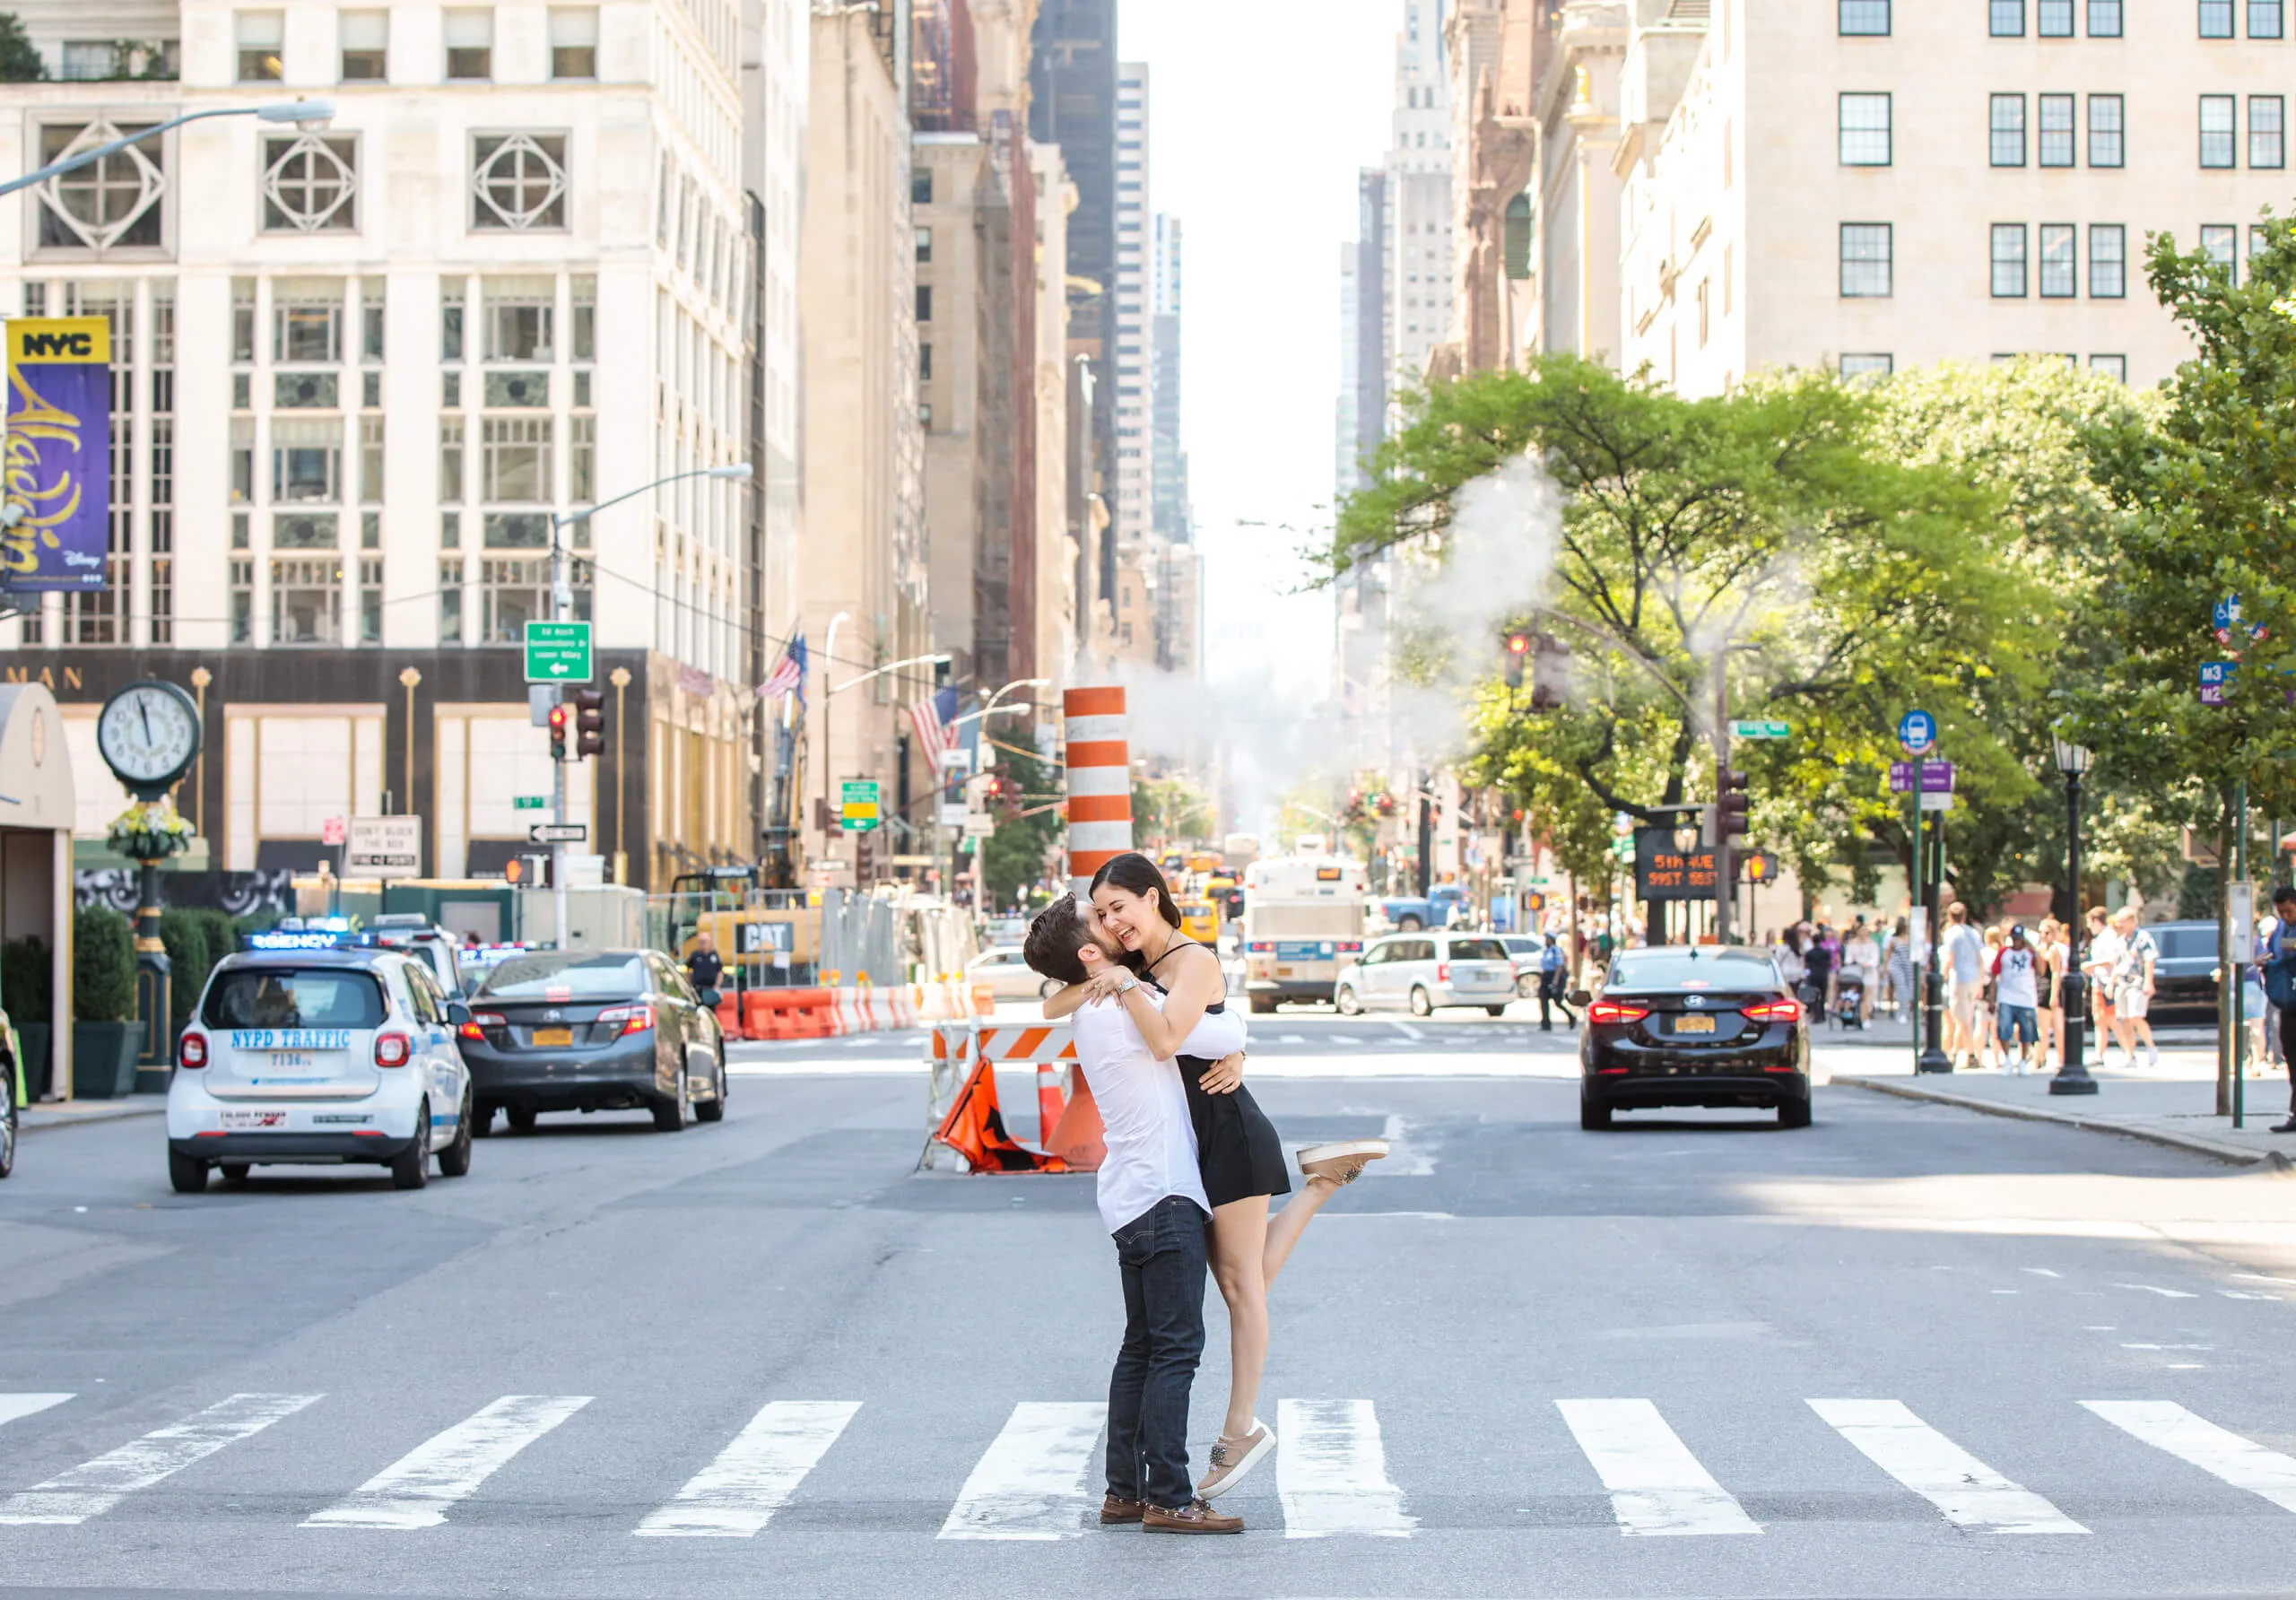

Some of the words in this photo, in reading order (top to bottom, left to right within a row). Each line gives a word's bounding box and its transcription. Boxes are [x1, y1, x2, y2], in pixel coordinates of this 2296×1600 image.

[23, 333, 91, 357] NYC
[2203, 665, 2222, 681] M3
[2202, 686, 2221, 701] M2
[745, 924, 787, 951] CAT
[231, 1030, 274, 1048] NYPD
[282, 1030, 351, 1048] TRAFFIC
